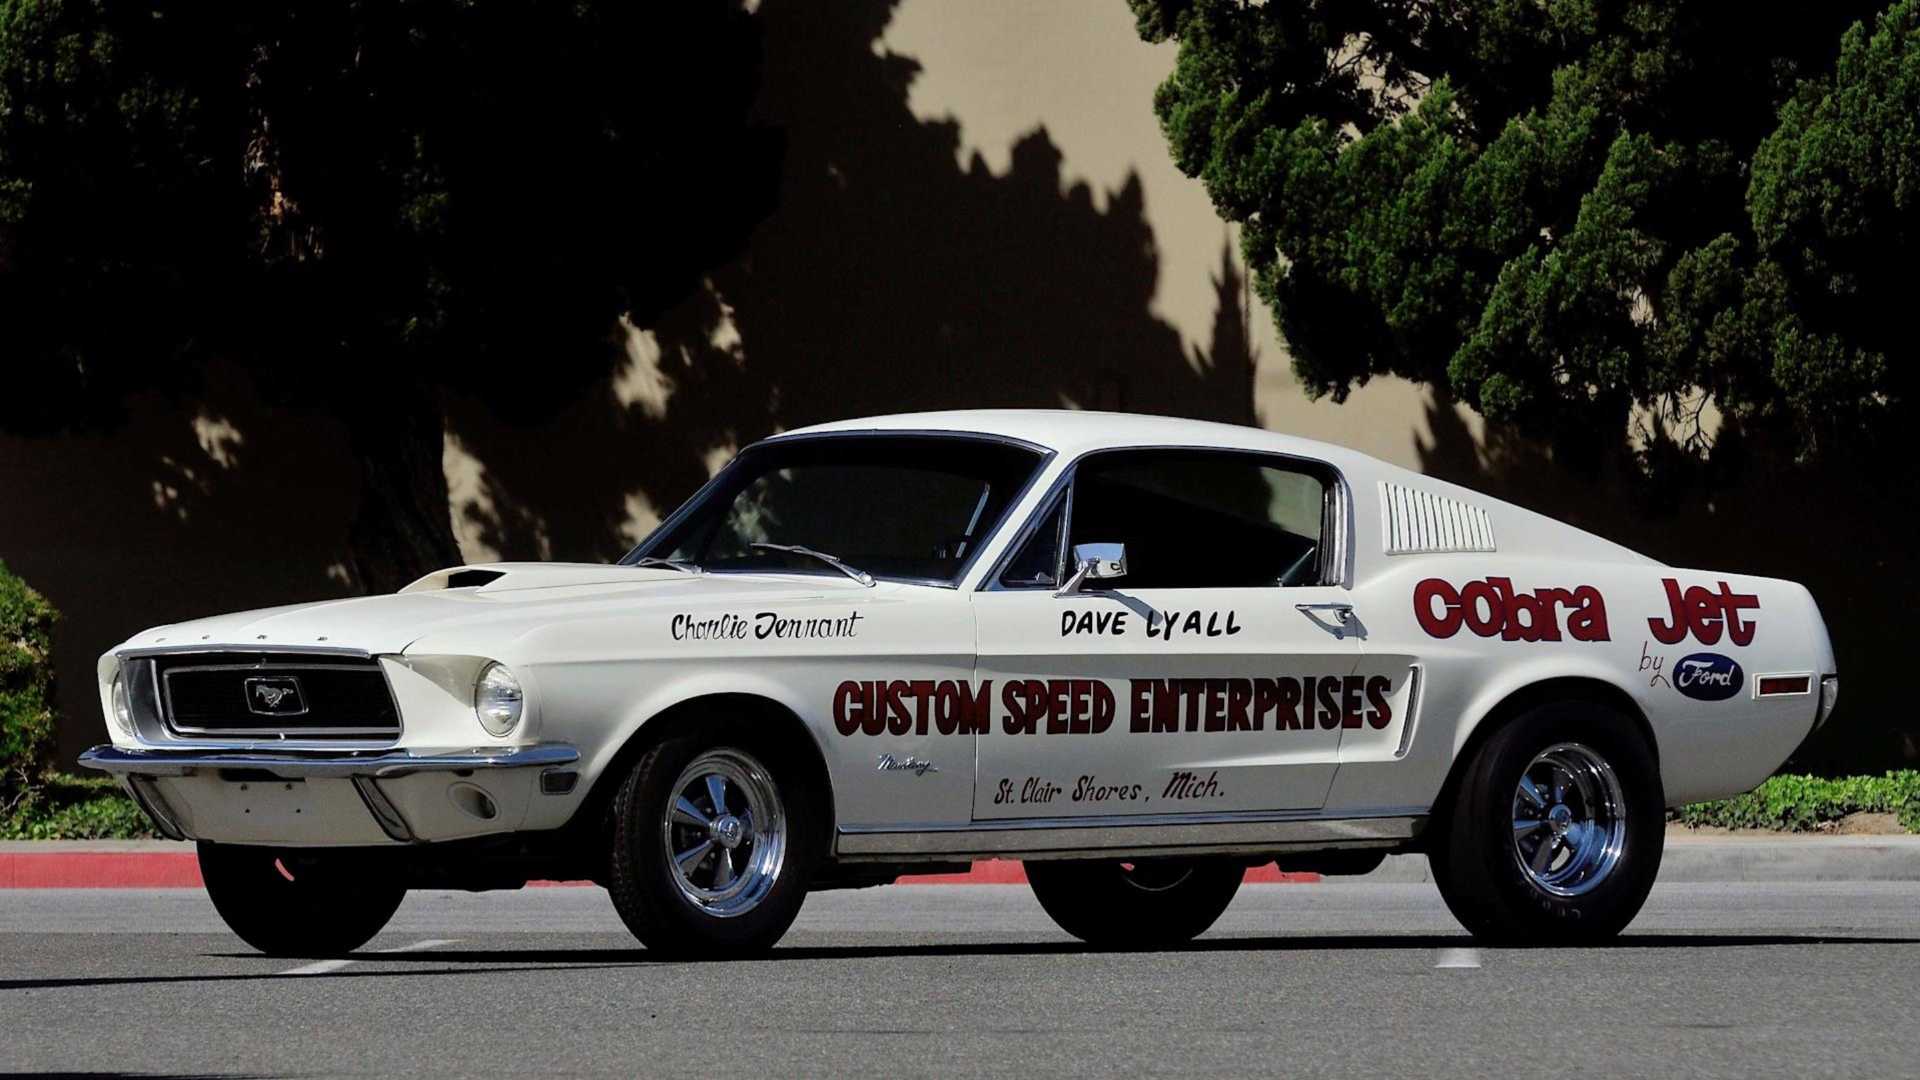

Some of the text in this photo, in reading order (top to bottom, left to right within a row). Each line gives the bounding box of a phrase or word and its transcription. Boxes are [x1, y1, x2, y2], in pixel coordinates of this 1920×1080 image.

[671, 613, 748, 641] Charlie
[1061, 610, 1241, 641] DAVE LYALL
[1413, 576, 1760, 647] Cobra Jet
[1639, 640, 1735, 688] by Ford
[833, 675, 1392, 736] CUSTOM SPEED ENTERPRISES
[994, 778, 1015, 804] St.
[1020, 776, 1063, 804] Clair
[1162, 770, 1226, 799] Mich.
